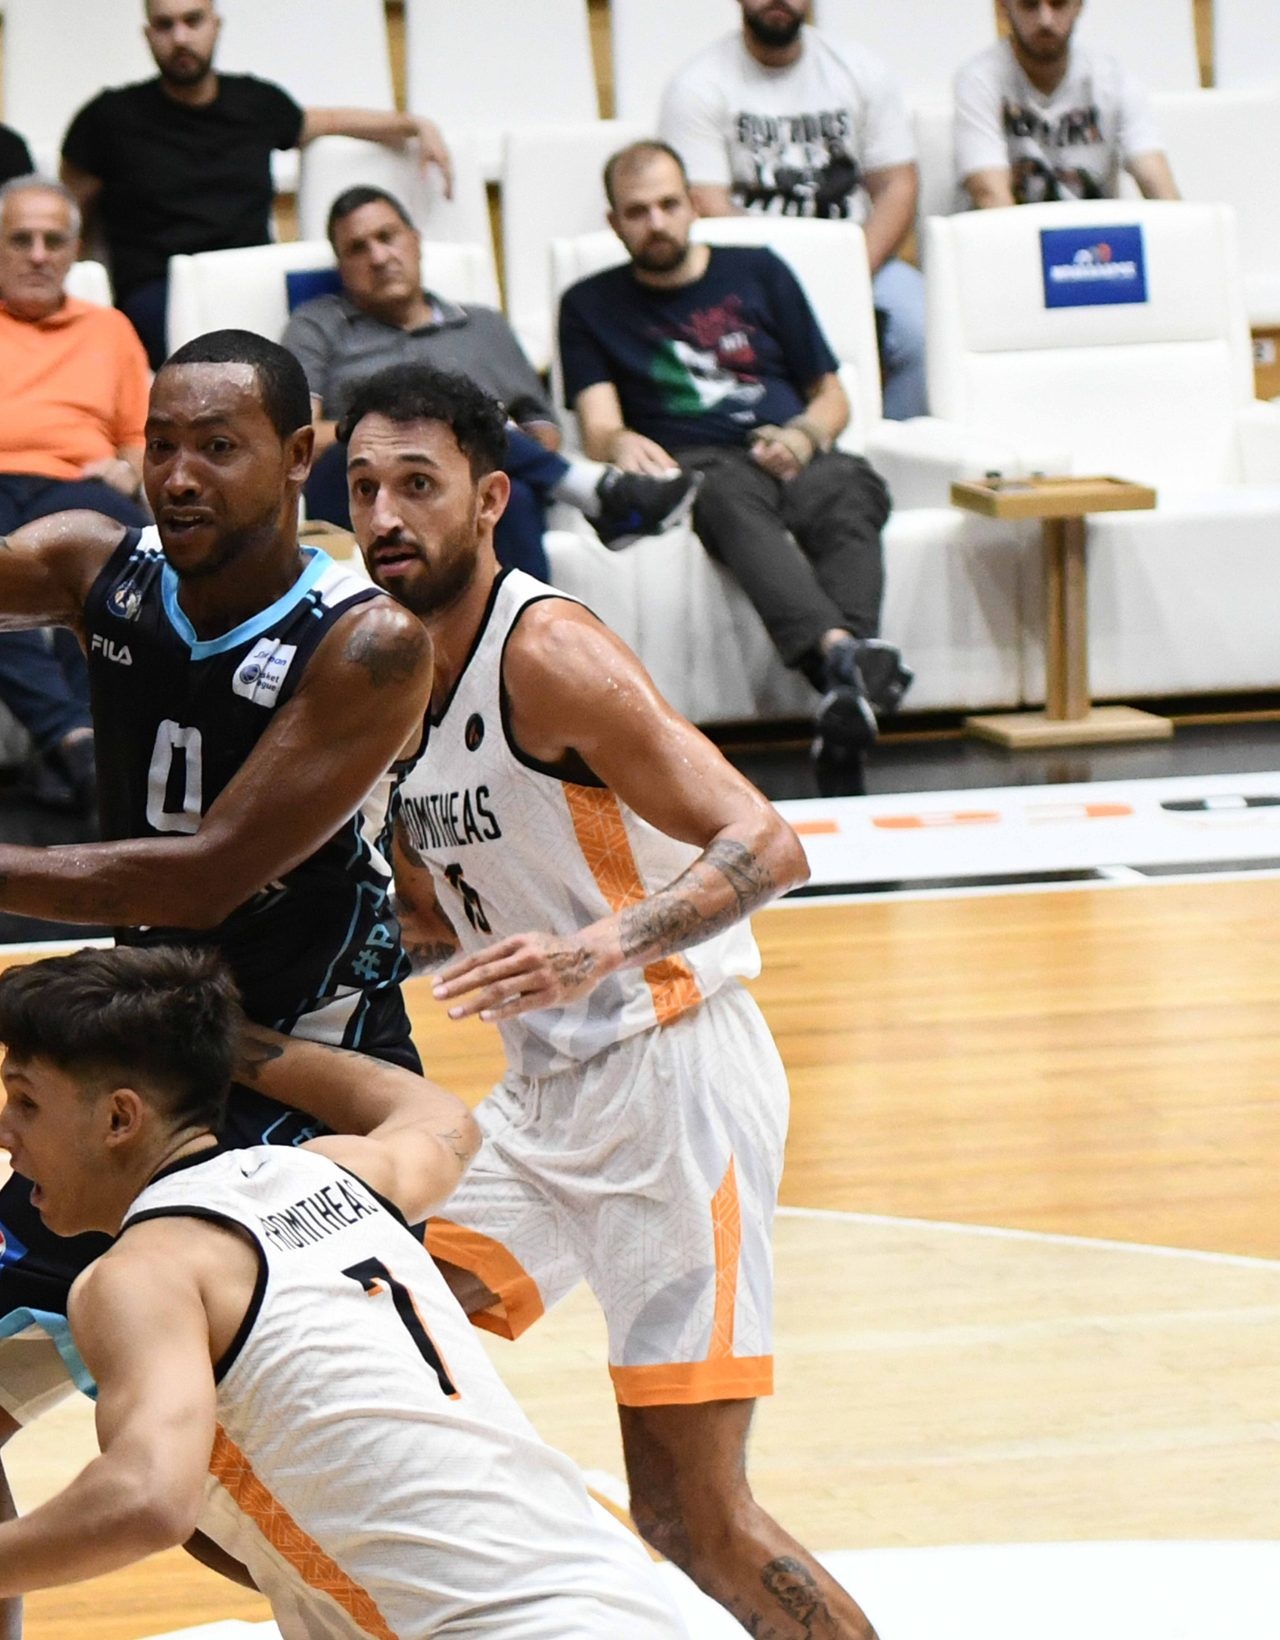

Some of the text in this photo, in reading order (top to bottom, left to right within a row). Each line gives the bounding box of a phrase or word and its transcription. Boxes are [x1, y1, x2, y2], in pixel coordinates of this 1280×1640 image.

[91, 633, 133, 666] FILA
[146, 718, 202, 834] 0
[255, 1178, 379, 1252] PROMITHEAS
[340, 1256, 461, 1401] 7
